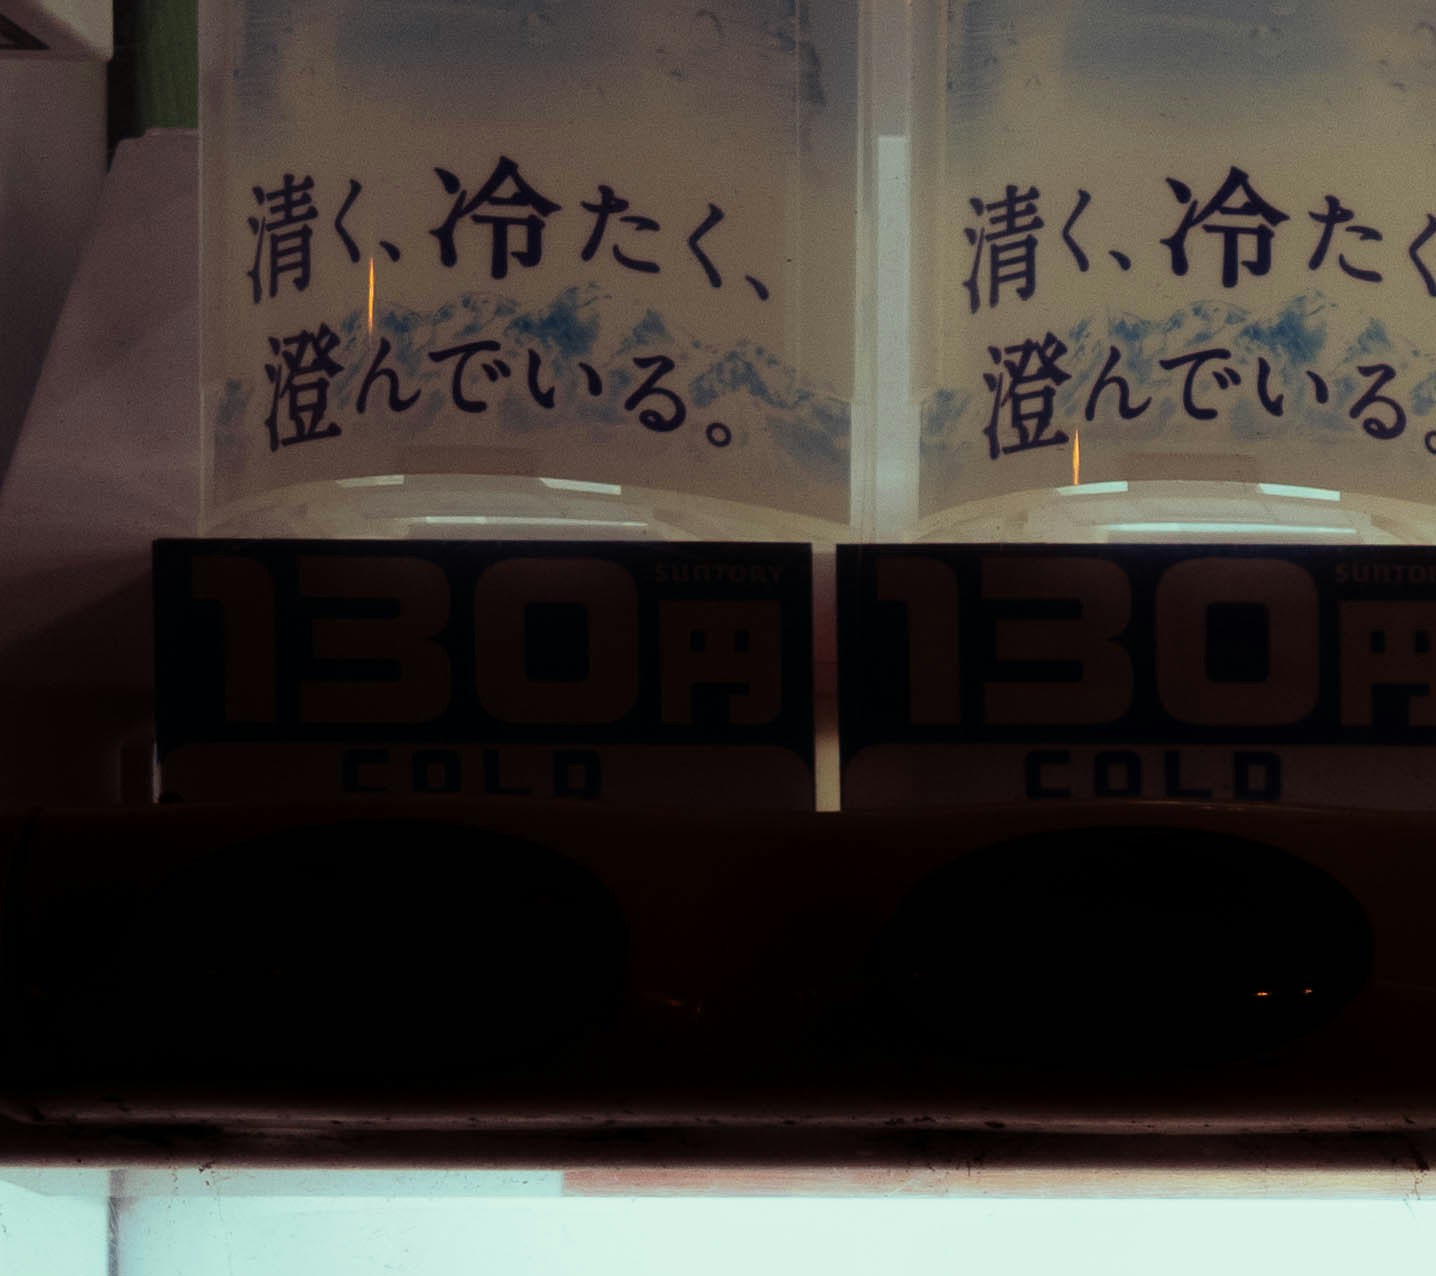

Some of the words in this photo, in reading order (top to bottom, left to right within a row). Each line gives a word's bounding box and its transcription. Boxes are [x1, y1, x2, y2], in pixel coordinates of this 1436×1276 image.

[247, 156, 769, 304] 清く、冷たく、
[264, 323, 731, 452] 澄んでいる。
[342, 749, 599, 797] COLD
[1026, 752, 1281, 799] COLD
